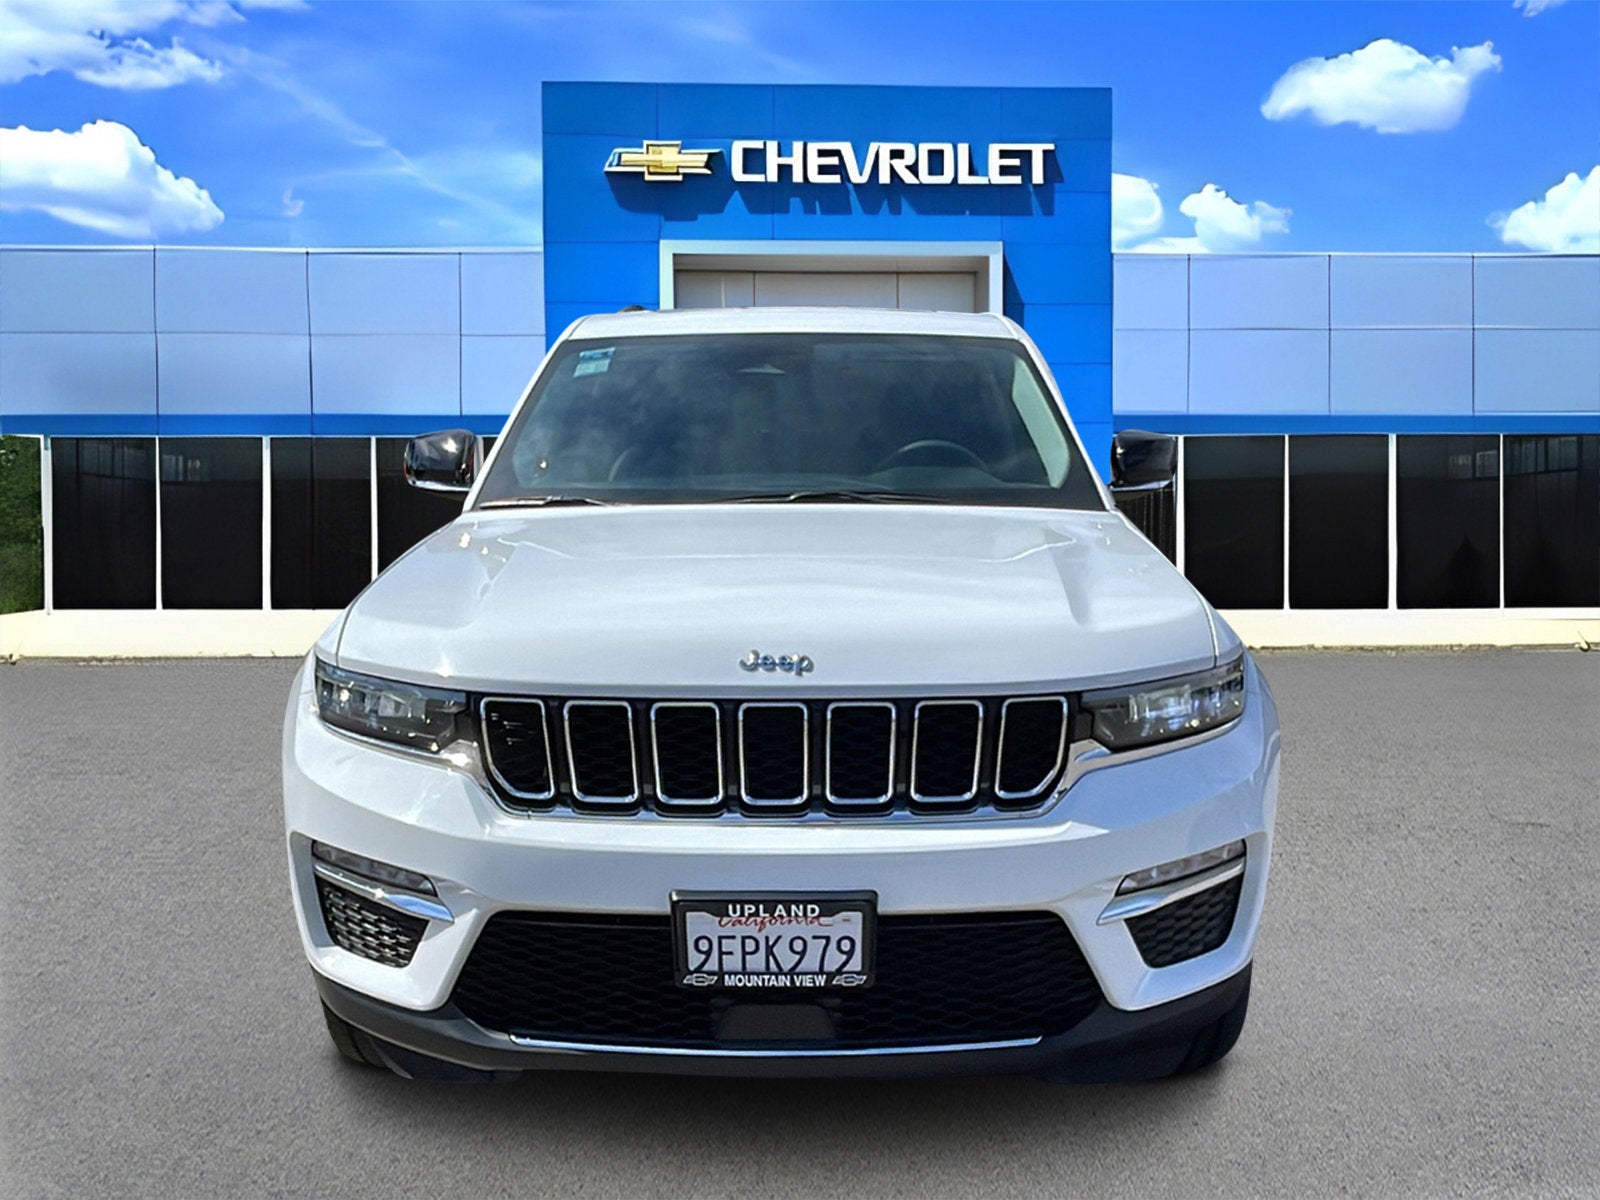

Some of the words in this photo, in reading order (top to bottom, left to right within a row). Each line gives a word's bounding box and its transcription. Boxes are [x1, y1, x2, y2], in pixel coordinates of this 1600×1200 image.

[731, 140, 1055, 186] CHEVROLET
[739, 650, 814, 677] Jeep
[728, 904, 820, 917] UPLAND
[693, 935, 856, 972] 9FPK979
[724, 974, 790, 986] MOUNTAIN
[793, 974, 826, 986] VIEW
